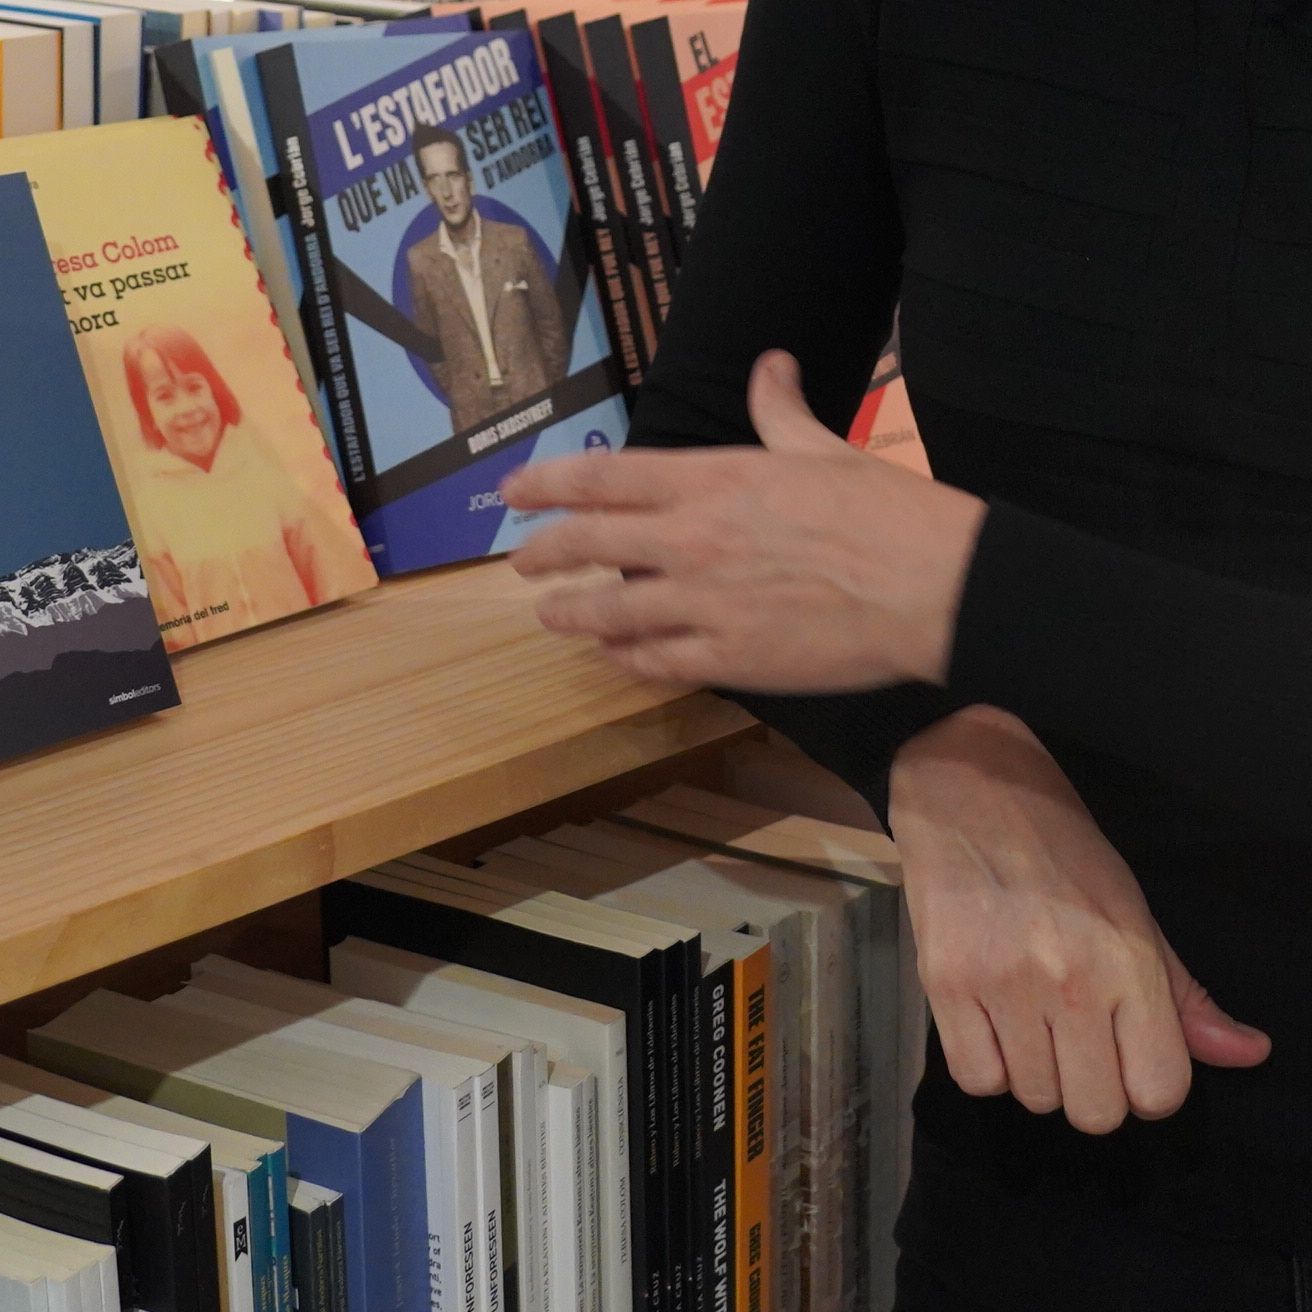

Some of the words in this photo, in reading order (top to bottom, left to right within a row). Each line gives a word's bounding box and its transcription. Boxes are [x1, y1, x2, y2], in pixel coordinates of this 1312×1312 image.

[689, 30, 719, 72] EL
[333, 37, 520, 171] L'ESTAFADOR
[338, 176, 387, 233] QUE
[385, 157, 420, 206] VA
[465, 108, 512, 162] SER
[506, 91, 548, 138] REI
[292, 185, 316, 228] Jorge
[101, 233, 180, 264] Colom
[73, 280, 106, 303] va
[109, 261, 191, 301] passar
[323, 326, 341, 353] SER
[328, 351, 345, 372] VA
[333, 369, 352, 400] QUE
[339, 398, 366, 484] L'ESTAFADOR
[468, 490, 505, 512] JORG
[159, 614, 192, 632] emòria
[193, 608, 209, 621] del
[209, 600, 230, 616] fred
[712, 983, 726, 1042] GREG
[747, 983, 766, 1033] THE
[747, 1032, 765, 1077] FAT
[712, 1044, 727, 1133] COONEN
[747, 1077, 765, 1164] FINGER
[714, 1178, 727, 1220] THE
[464, 1220, 475, 1312] NFORESEEN
[487, 1208, 498, 1312] UNFORESEEN
[714, 1220, 728, 1275] WOLF
[749, 1221, 762, 1266] GREG
[714, 1276, 729, 1312] WIT
[749, 1267, 763, 1312] COON
